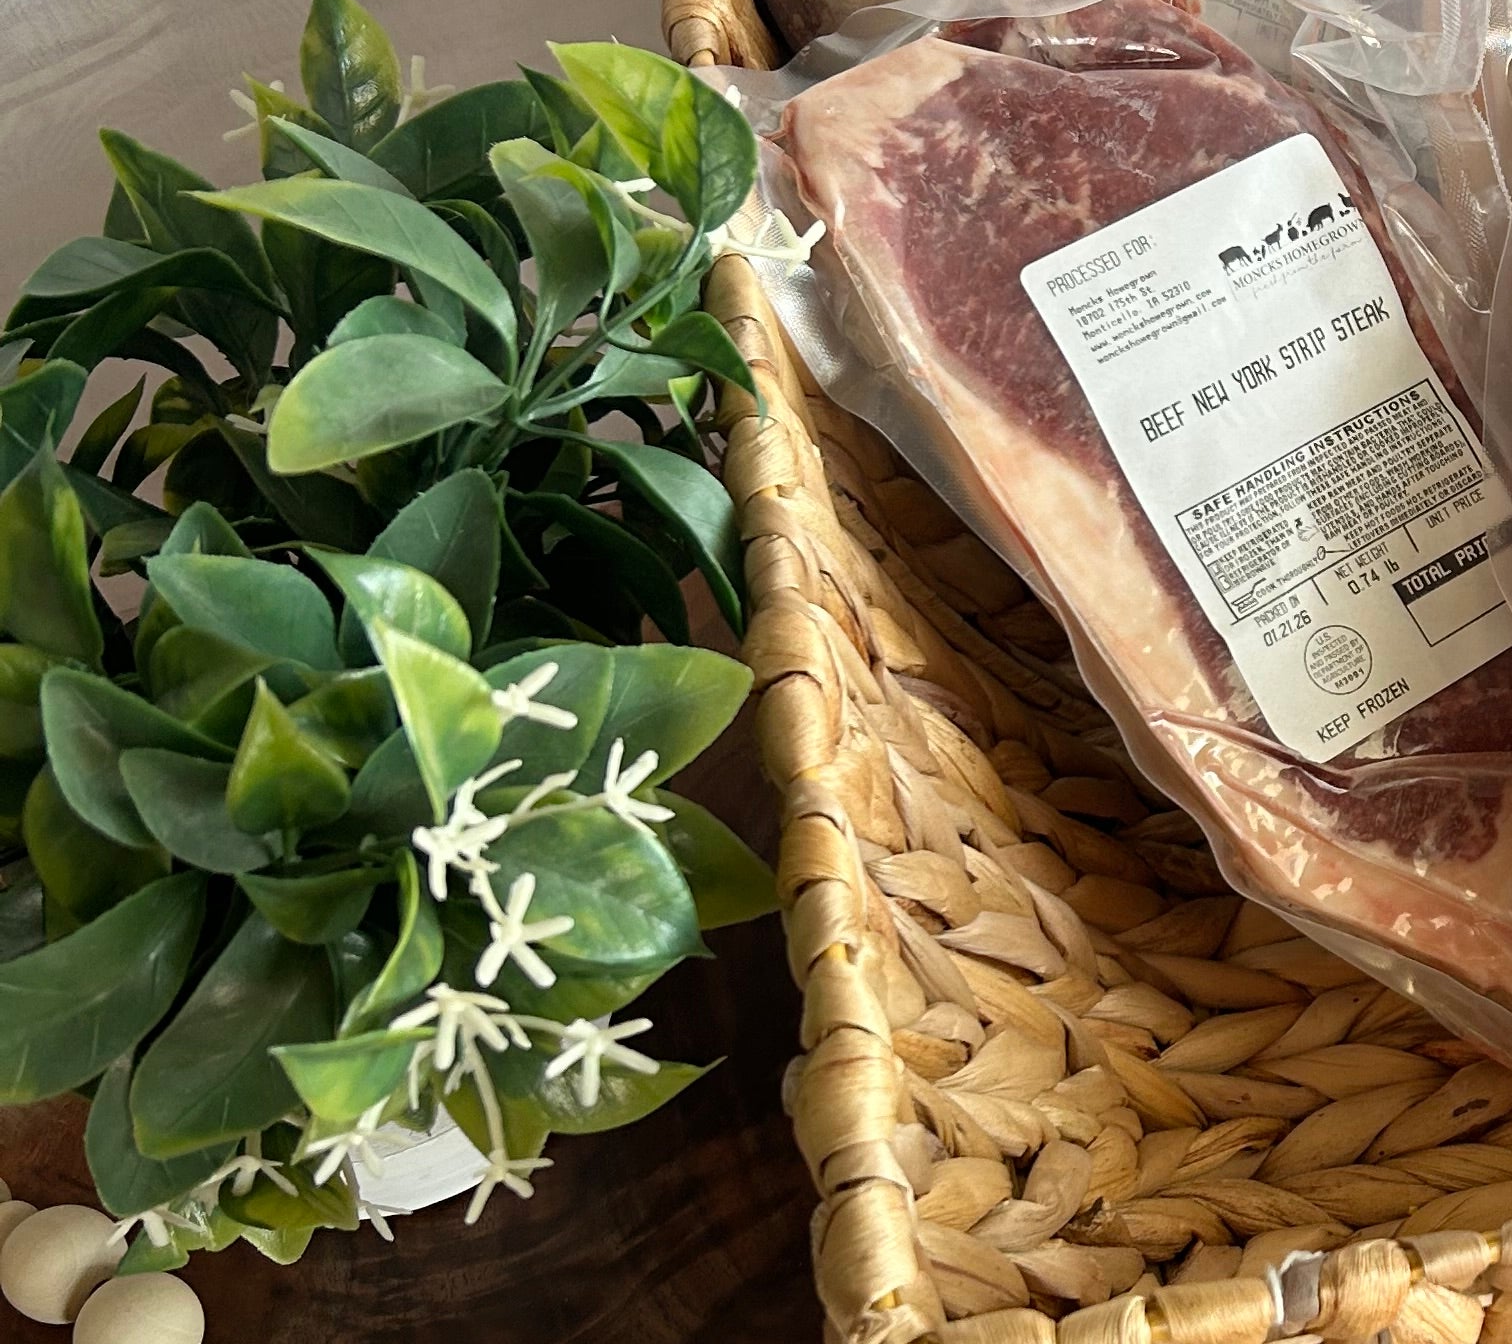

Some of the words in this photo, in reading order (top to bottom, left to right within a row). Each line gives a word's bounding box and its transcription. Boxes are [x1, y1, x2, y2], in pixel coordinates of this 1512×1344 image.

[1045, 248, 1122, 298] PROCESSED
[1121, 231, 1158, 260] FOR:
[1230, 256, 1284, 291] MONCKS
[1067, 292, 1104, 317] Moncks
[1105, 266, 1159, 299] Homegrown
[1074, 306, 1107, 328] 18702
[1107, 290, 1138, 312] 175th
[1145, 295, 1160, 309] IA
[1160, 279, 1192, 302] 52310
[1137, 398, 1192, 443] BEEF
[1189, 378, 1231, 416] NEW
[1229, 353, 1280, 395] YORK
[1276, 326, 1332, 371] STRIP
[1328, 295, 1393, 344] STEAK
[1190, 491, 1233, 522] SAFE
[1233, 450, 1307, 498] HANDLING
[1307, 388, 1421, 458] INSTRUCTIONS
[1424, 506, 1451, 528] UNIT
[1452, 487, 1485, 514] PRICE
[1332, 560, 1354, 581] NET
[1353, 541, 1391, 570] WEIGHT
[1346, 567, 1381, 596] 0.74
[1383, 556, 1401, 575] lb
[1401, 557, 1453, 597] TOTAL
[1253, 601, 1290, 629] PACKED
[1260, 609, 1312, 648] 01.21.26
[1314, 710, 1355, 745] KEEP
[1354, 676, 1413, 722] FROZEN
